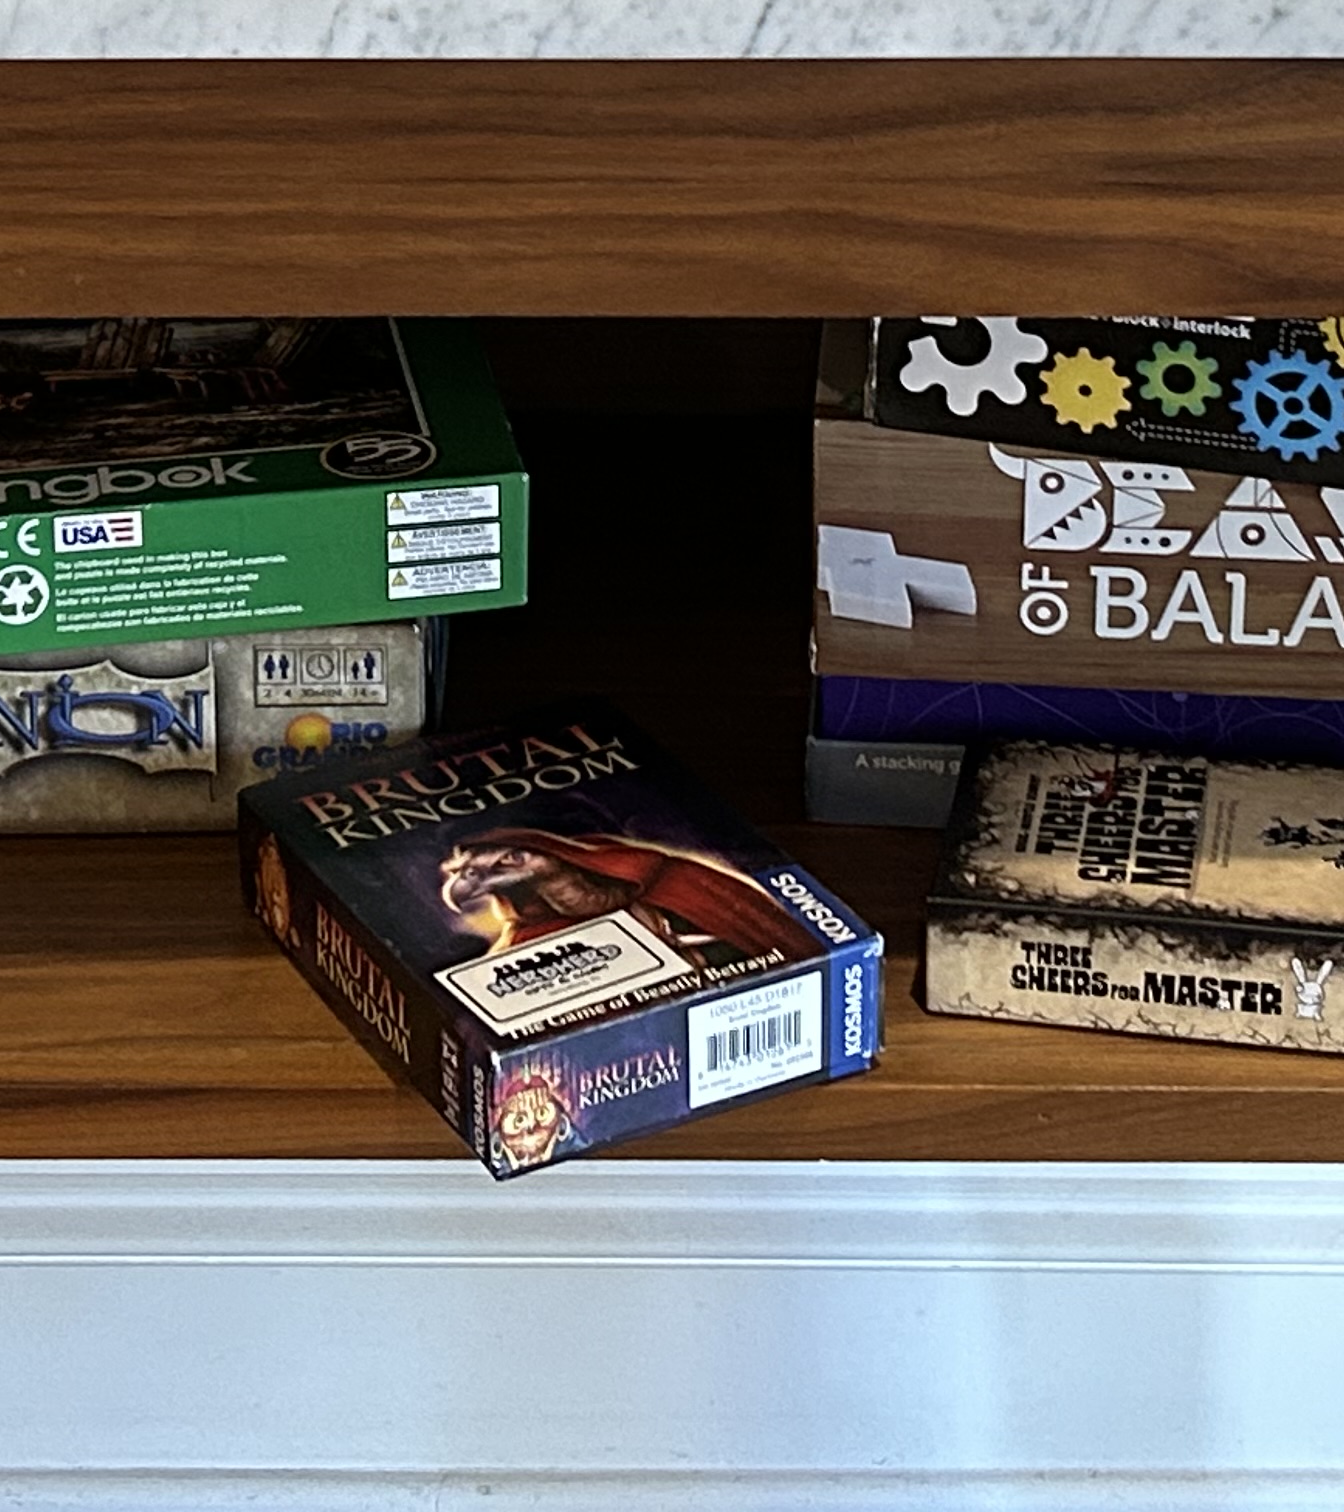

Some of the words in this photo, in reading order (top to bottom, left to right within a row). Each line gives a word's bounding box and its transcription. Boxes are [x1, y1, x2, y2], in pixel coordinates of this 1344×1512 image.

[61, 523, 109, 546] USA
[1018, 562, 1070, 637] OF
[331, 721, 388, 744] RIO
[856, 753, 870, 768] A
[872, 755, 944, 775] stacking
[296, 724, 625, 825] BRUTAL
[324, 749, 641, 849] KINGDOM
[1130, 764, 1207, 888] MASTER
[770, 872, 856, 944] KOSMOS
[317, 900, 411, 1040] BRUTAL
[486, 943, 623, 998] NERDHERD
[548, 1000, 606, 1028] Game
[608, 990, 628, 1012] of
[634, 972, 703, 1006] Beastly
[704, 947, 787, 983] Betrayal
[1010, 963, 1109, 999] CHEERS
[1110, 983, 1141, 1002] FOR
[1143, 971, 1283, 1016] MASTER
[1021, 941, 1092, 968] THREE
[317, 940, 410, 1065] KINGDOM
[843, 963, 864, 1058] KOSMOS
[578, 1044, 683, 1095] BRUTAL
[579, 1064, 681, 1110] KINGDOM
[472, 1064, 486, 1158] KOSMOS
